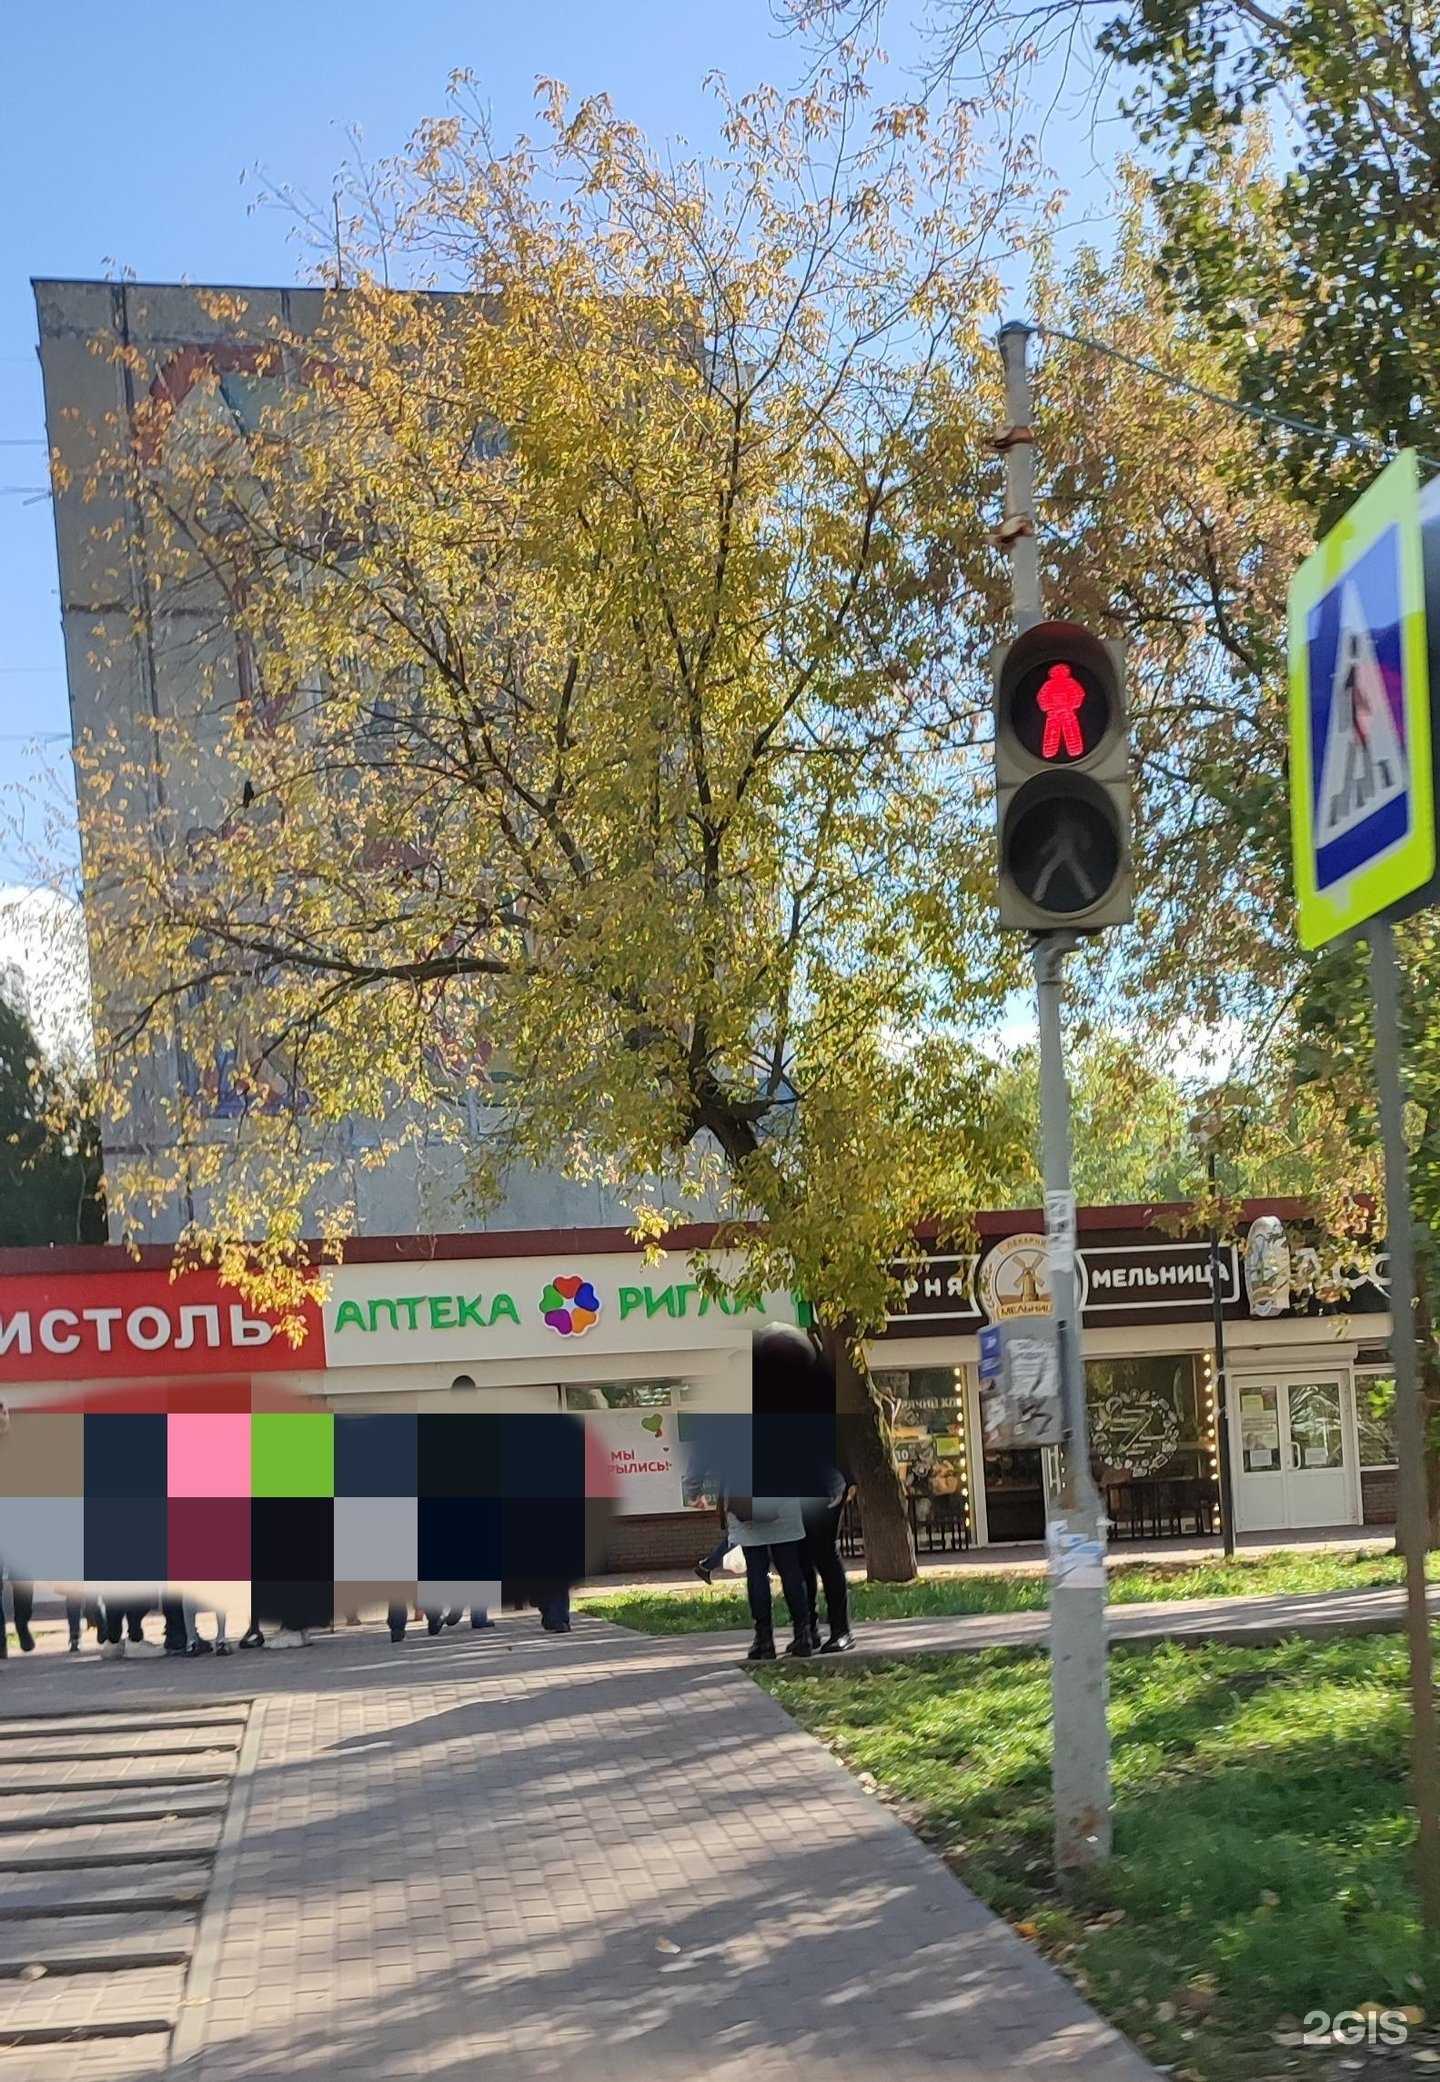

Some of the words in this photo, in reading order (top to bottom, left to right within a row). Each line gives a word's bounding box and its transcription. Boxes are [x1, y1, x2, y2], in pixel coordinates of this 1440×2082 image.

[904, 1278, 963, 1299] РНЯ
[1092, 1263, 1230, 1290] МЕЛЬНИЦА
[334, 1294, 521, 1335] АПТЕКА
[0, 1304, 276, 1355] ИСТОЛЬ
[611, 1450, 635, 1461] МЫ
